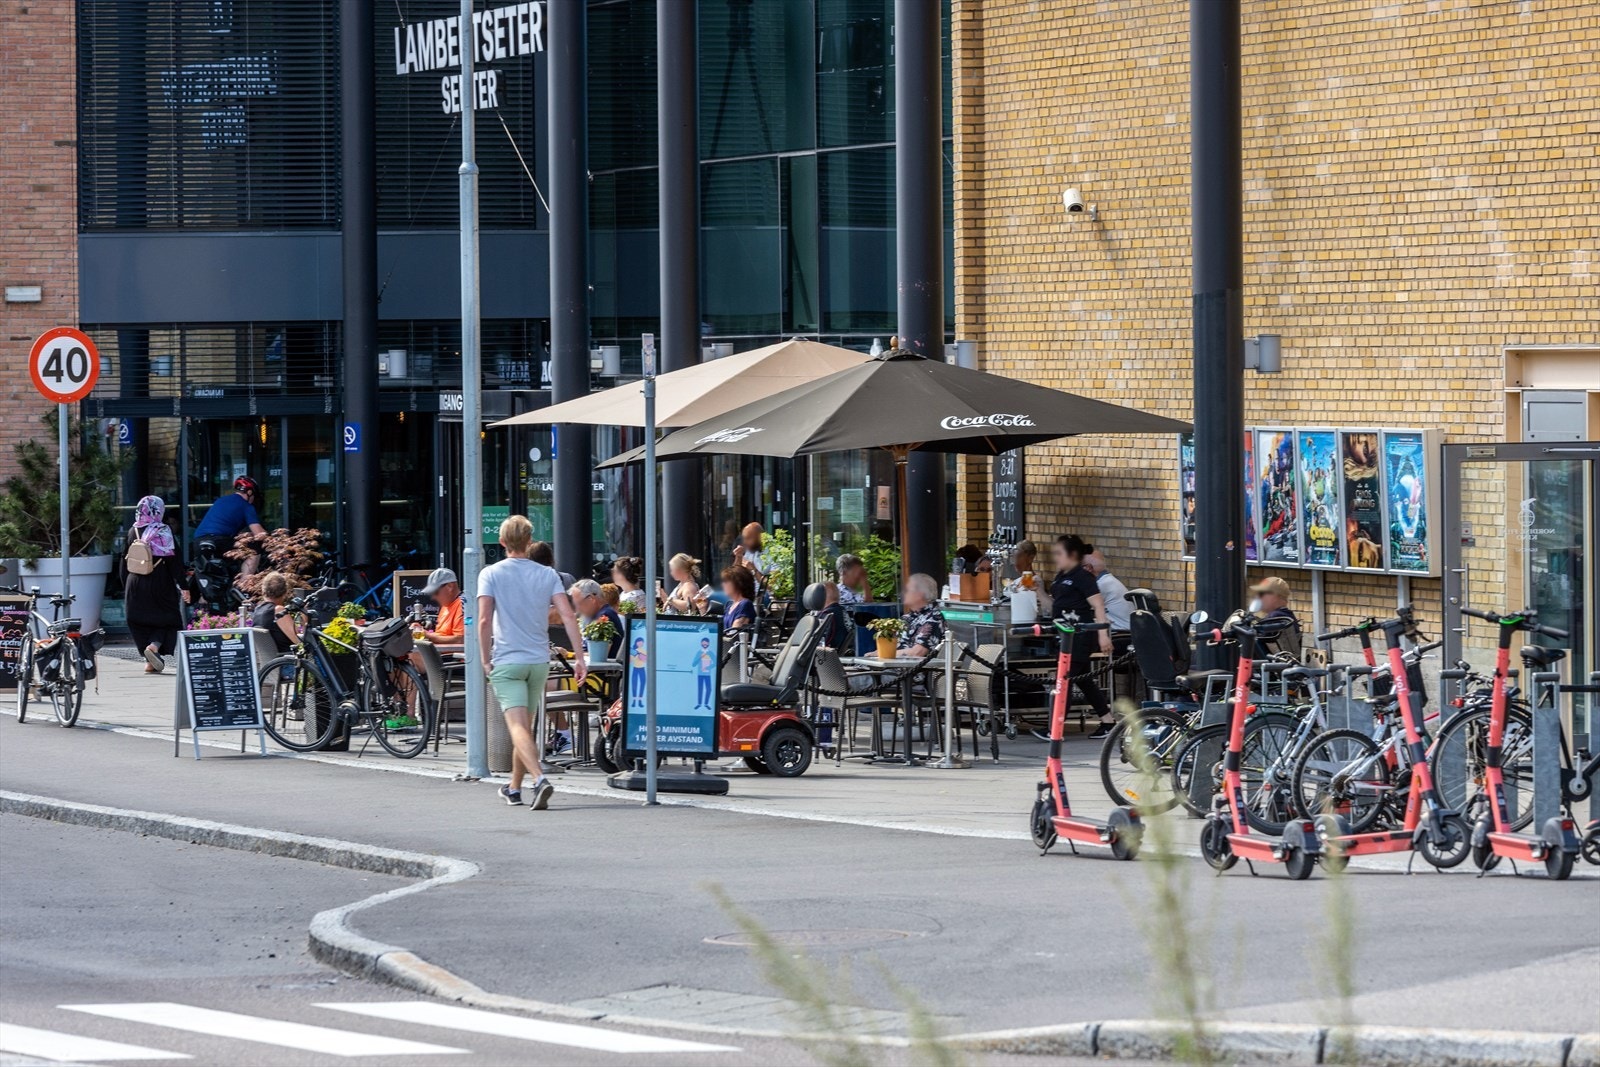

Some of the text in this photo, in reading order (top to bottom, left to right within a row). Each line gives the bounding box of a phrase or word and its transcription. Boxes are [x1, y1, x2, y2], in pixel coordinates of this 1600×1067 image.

[394, 1, 544, 75] LAMBETSETER
[442, 70, 498, 114] SETER
[42, 347, 88, 383] 40
[940, 413, 1033, 430] Coca-Cola
[188, 642, 217, 650] AGAVE
[662, 726, 700, 734] MINIMUM
